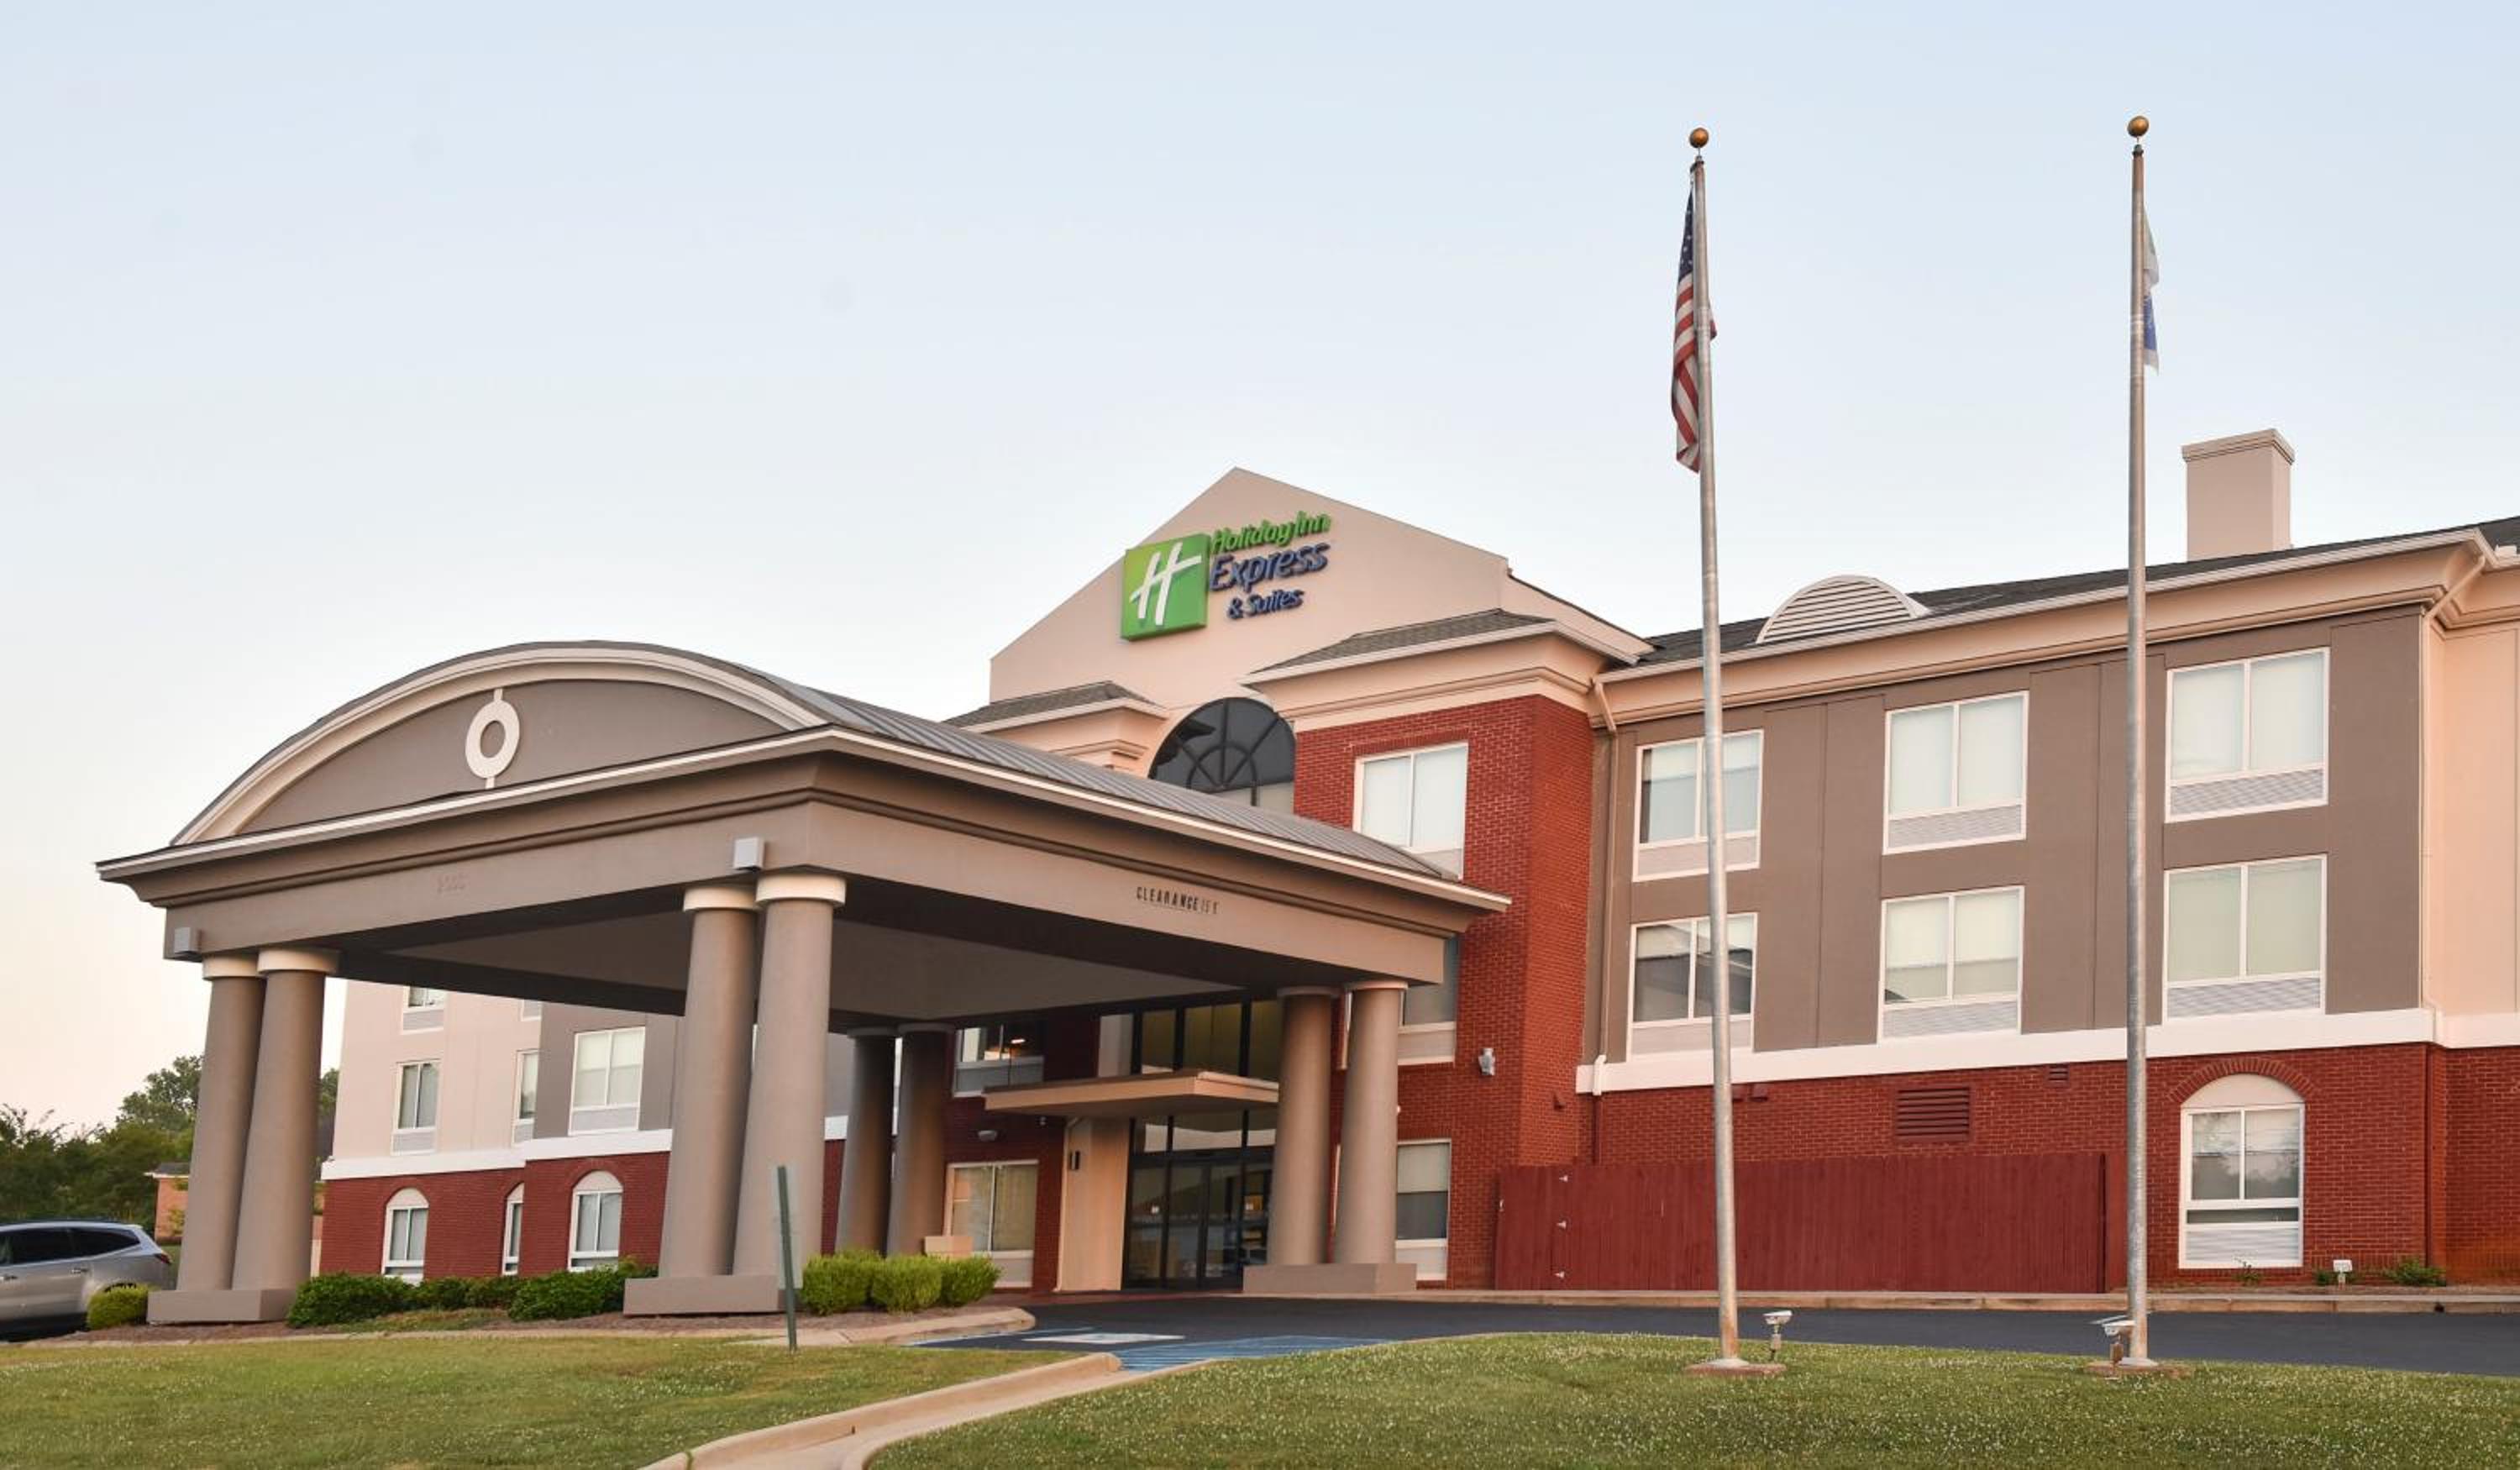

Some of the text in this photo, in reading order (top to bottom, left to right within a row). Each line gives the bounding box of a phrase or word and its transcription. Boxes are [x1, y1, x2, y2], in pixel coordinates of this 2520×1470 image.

[1210, 510, 1332, 554] Holiday Inn
[1209, 543, 1331, 594] Express
[1227, 590, 1305, 620] & Suites
[1136, 886, 1198, 911] CLEARANCE
